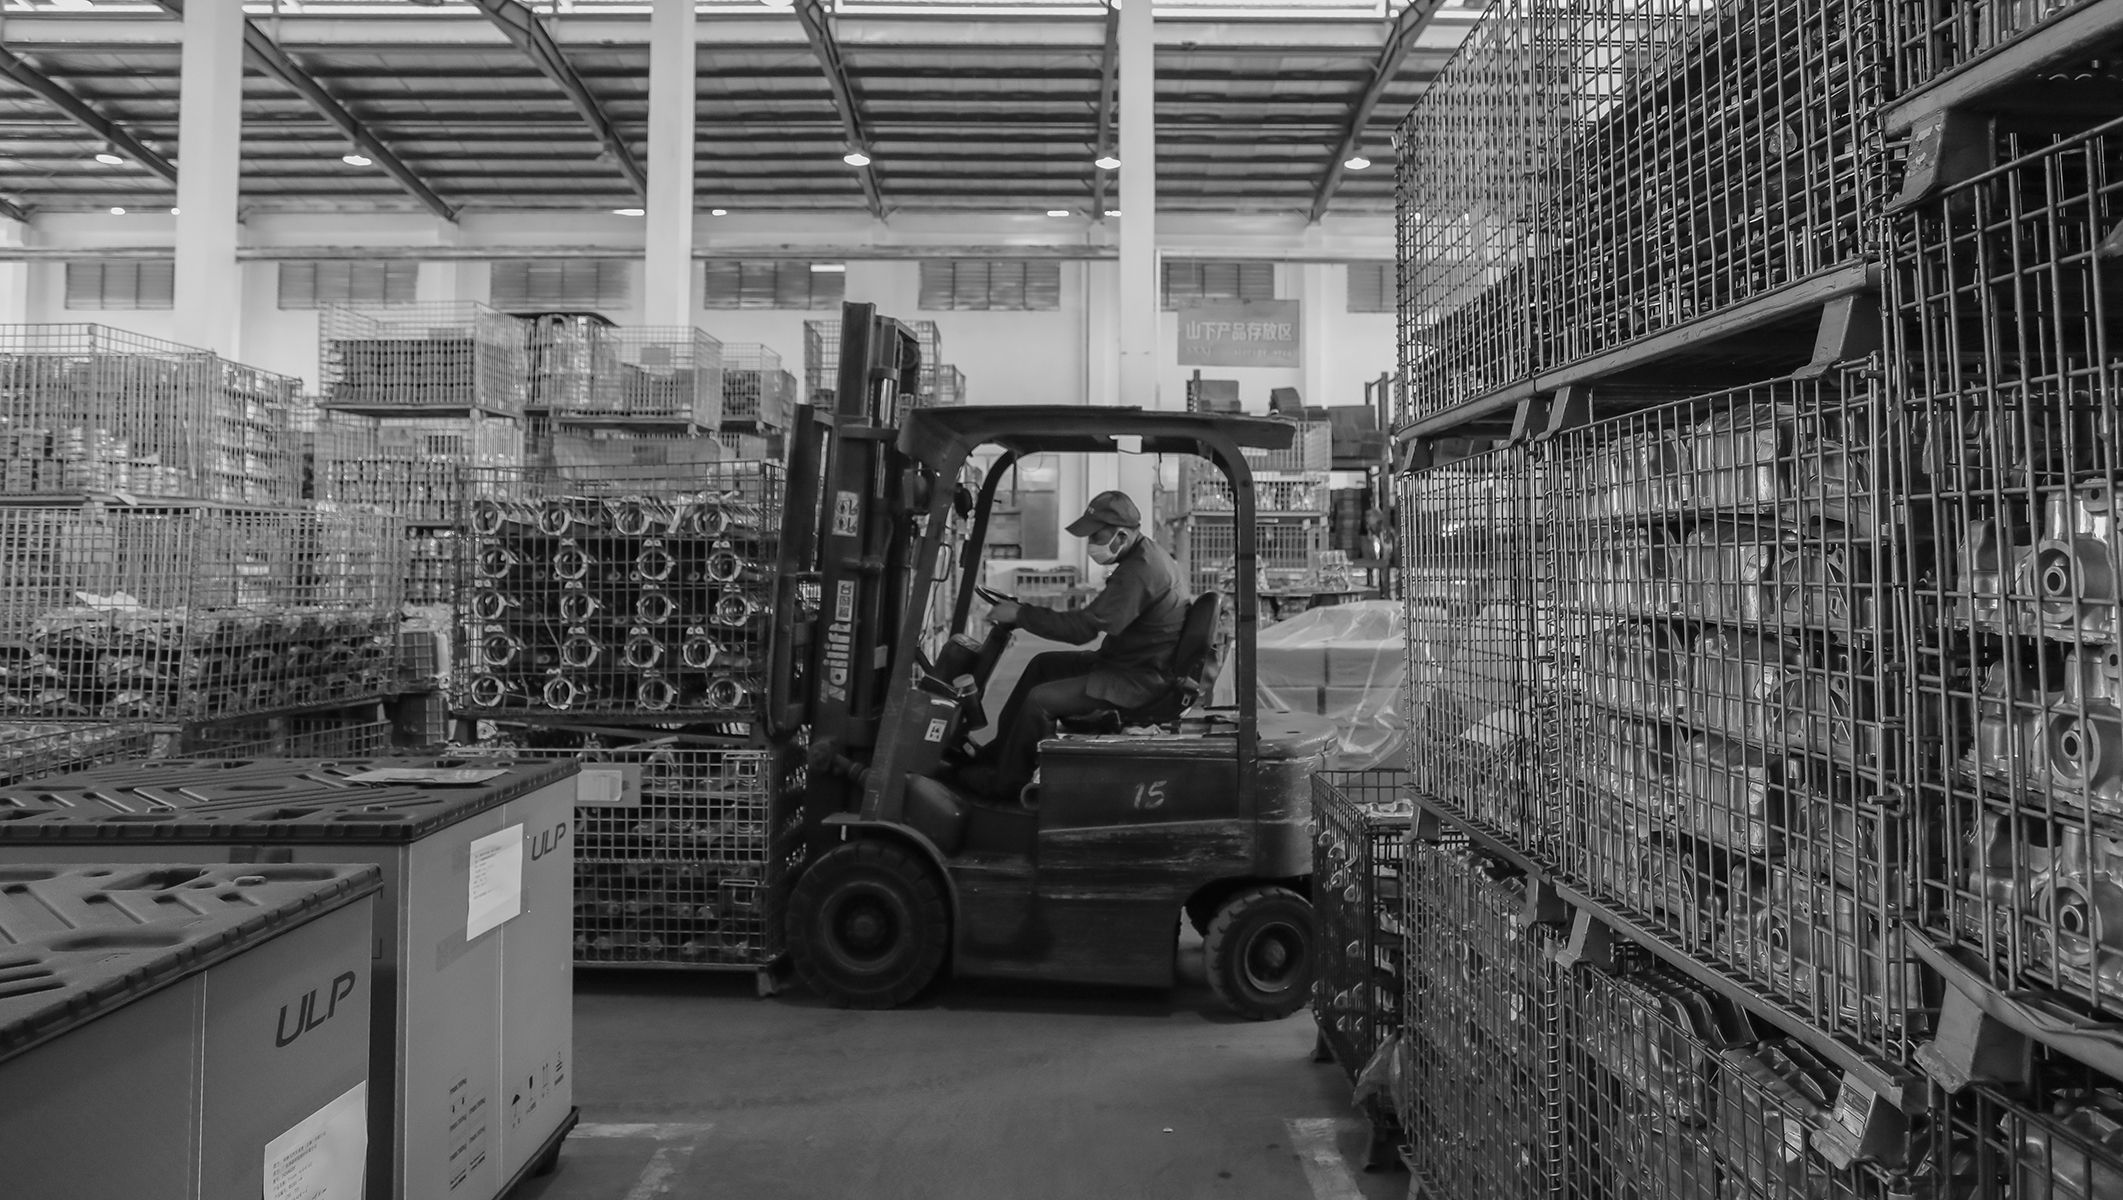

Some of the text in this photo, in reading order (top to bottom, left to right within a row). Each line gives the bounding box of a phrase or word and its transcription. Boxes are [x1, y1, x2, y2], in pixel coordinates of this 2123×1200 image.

[1186, 321, 1293, 341] 山下产品存放区
[1134, 780, 1167, 809] 15
[531, 822, 566, 861] ULP
[275, 970, 355, 1048] ULP
